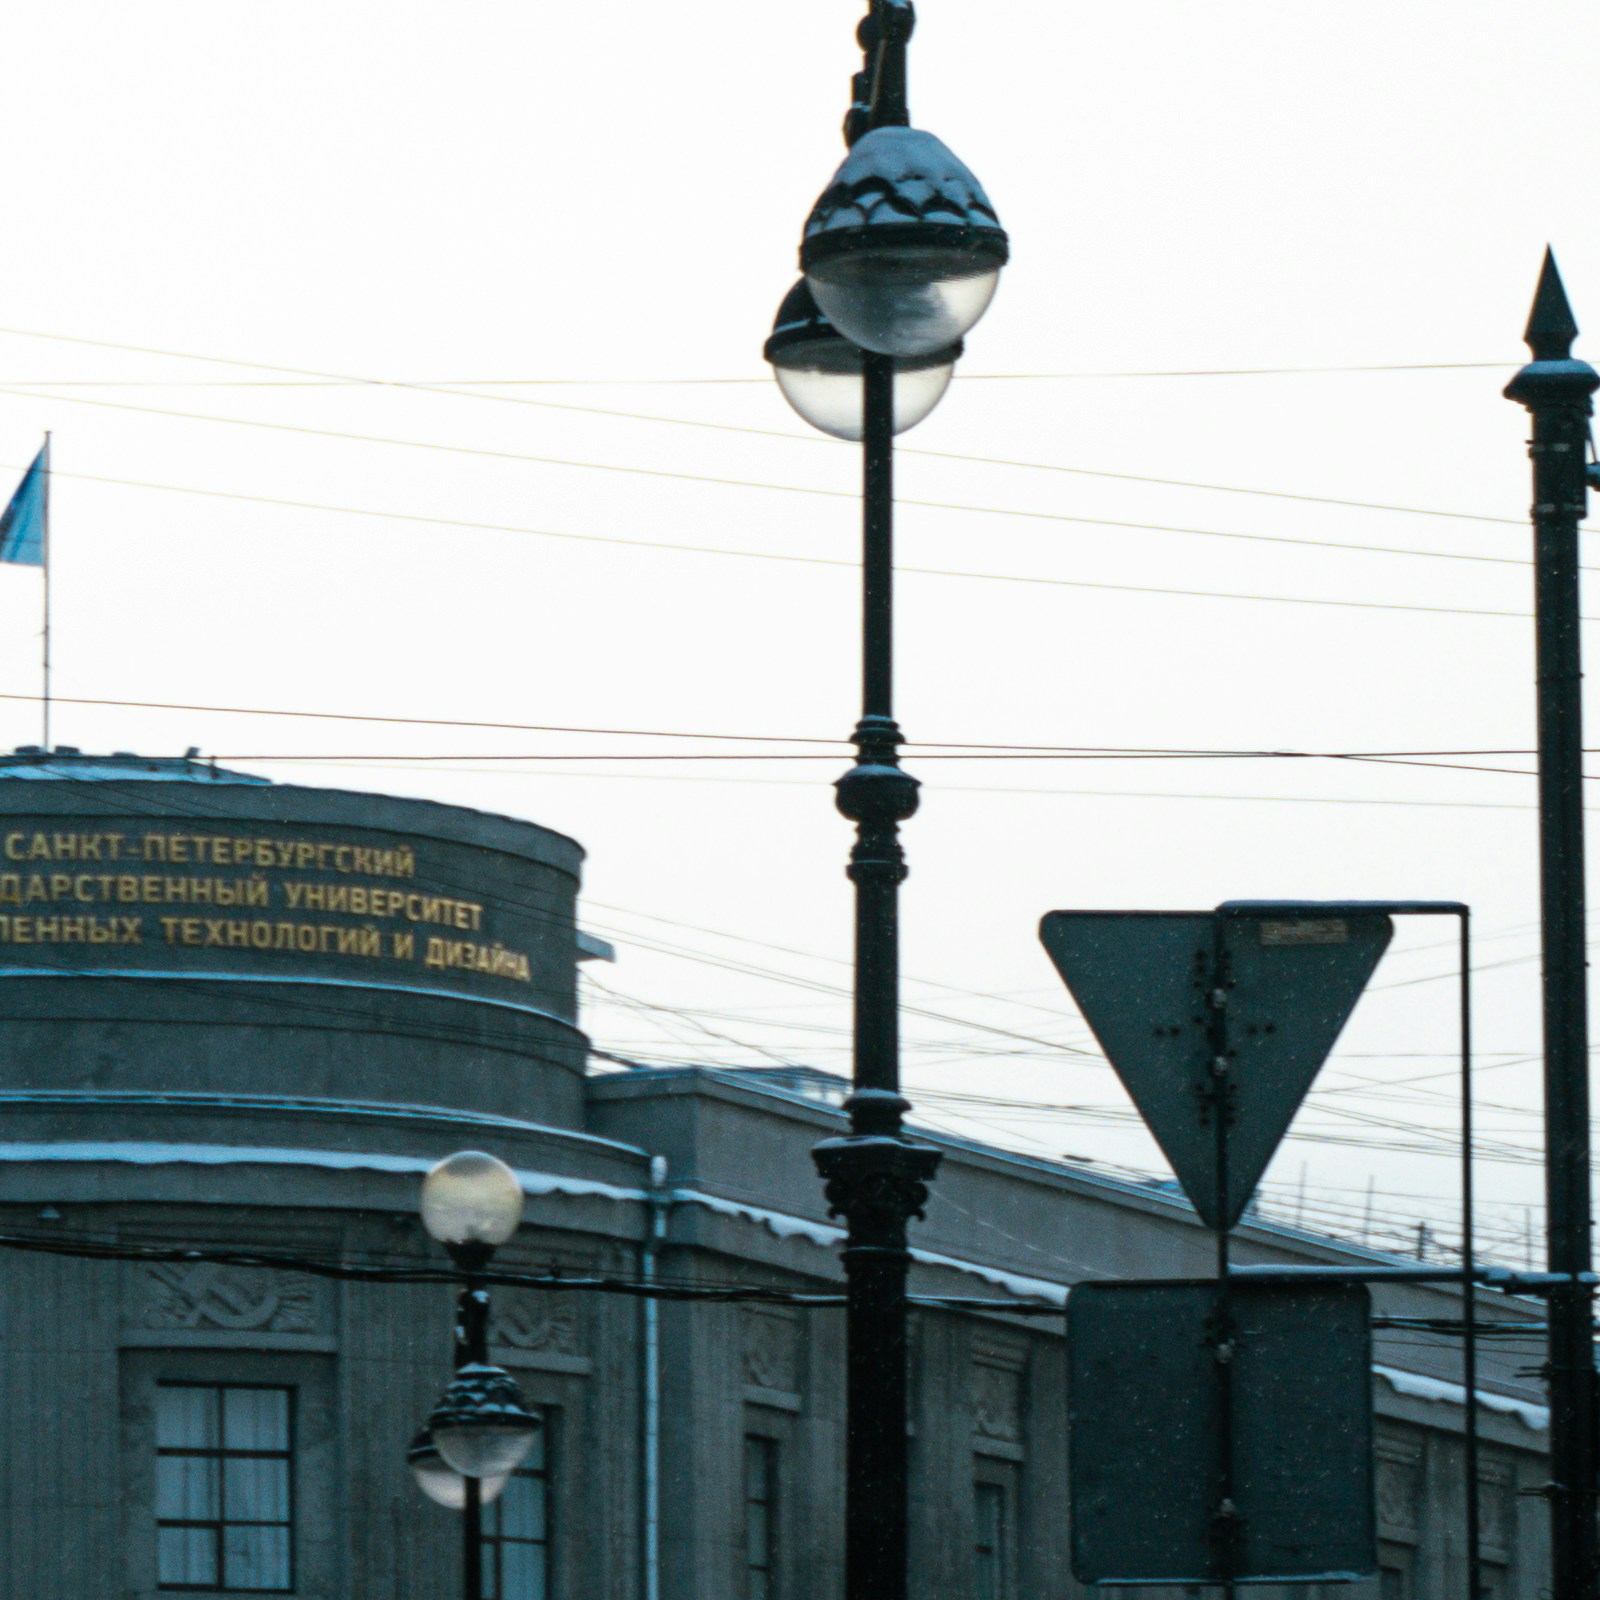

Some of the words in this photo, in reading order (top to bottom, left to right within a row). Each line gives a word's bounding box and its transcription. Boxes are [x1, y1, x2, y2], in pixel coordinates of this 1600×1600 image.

[4, 830, 416, 880] САНКТ-ПЕТЕРБУРГСКИЙ
[283, 881, 484, 931] УНИВЕРСИТЕТ
[160, 915, 381, 959] ТЕХНОЛОГИЙ
[394, 930, 414, 961] И
[424, 936, 532, 982] ДИЗАЙНА
